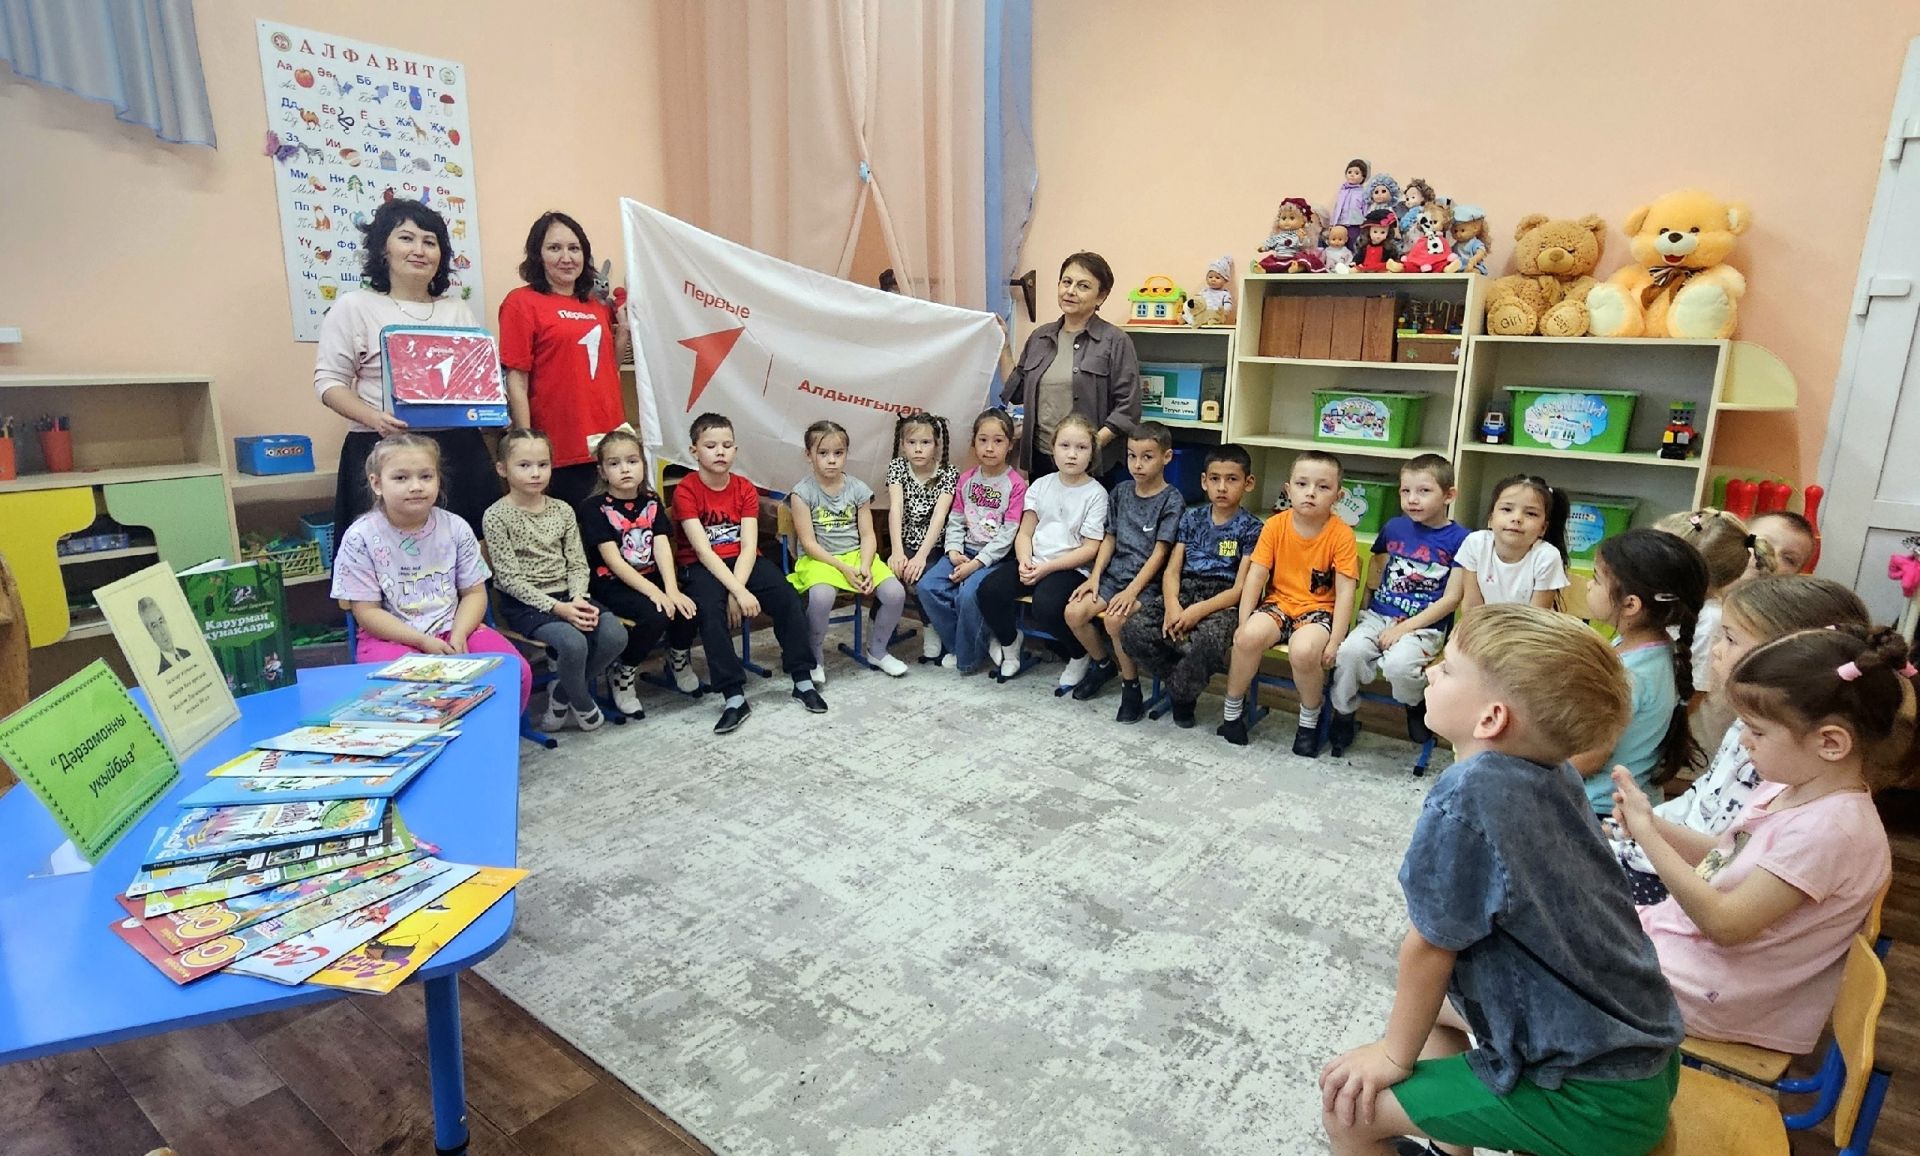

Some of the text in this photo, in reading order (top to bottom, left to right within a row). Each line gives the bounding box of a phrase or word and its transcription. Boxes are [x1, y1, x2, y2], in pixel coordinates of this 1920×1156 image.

[277, 60, 292, 71] Аа
[300, 39, 434, 79] АЛФАВИТ
[684, 280, 750, 319] Первые
[205, 613, 268, 631] Карурман
